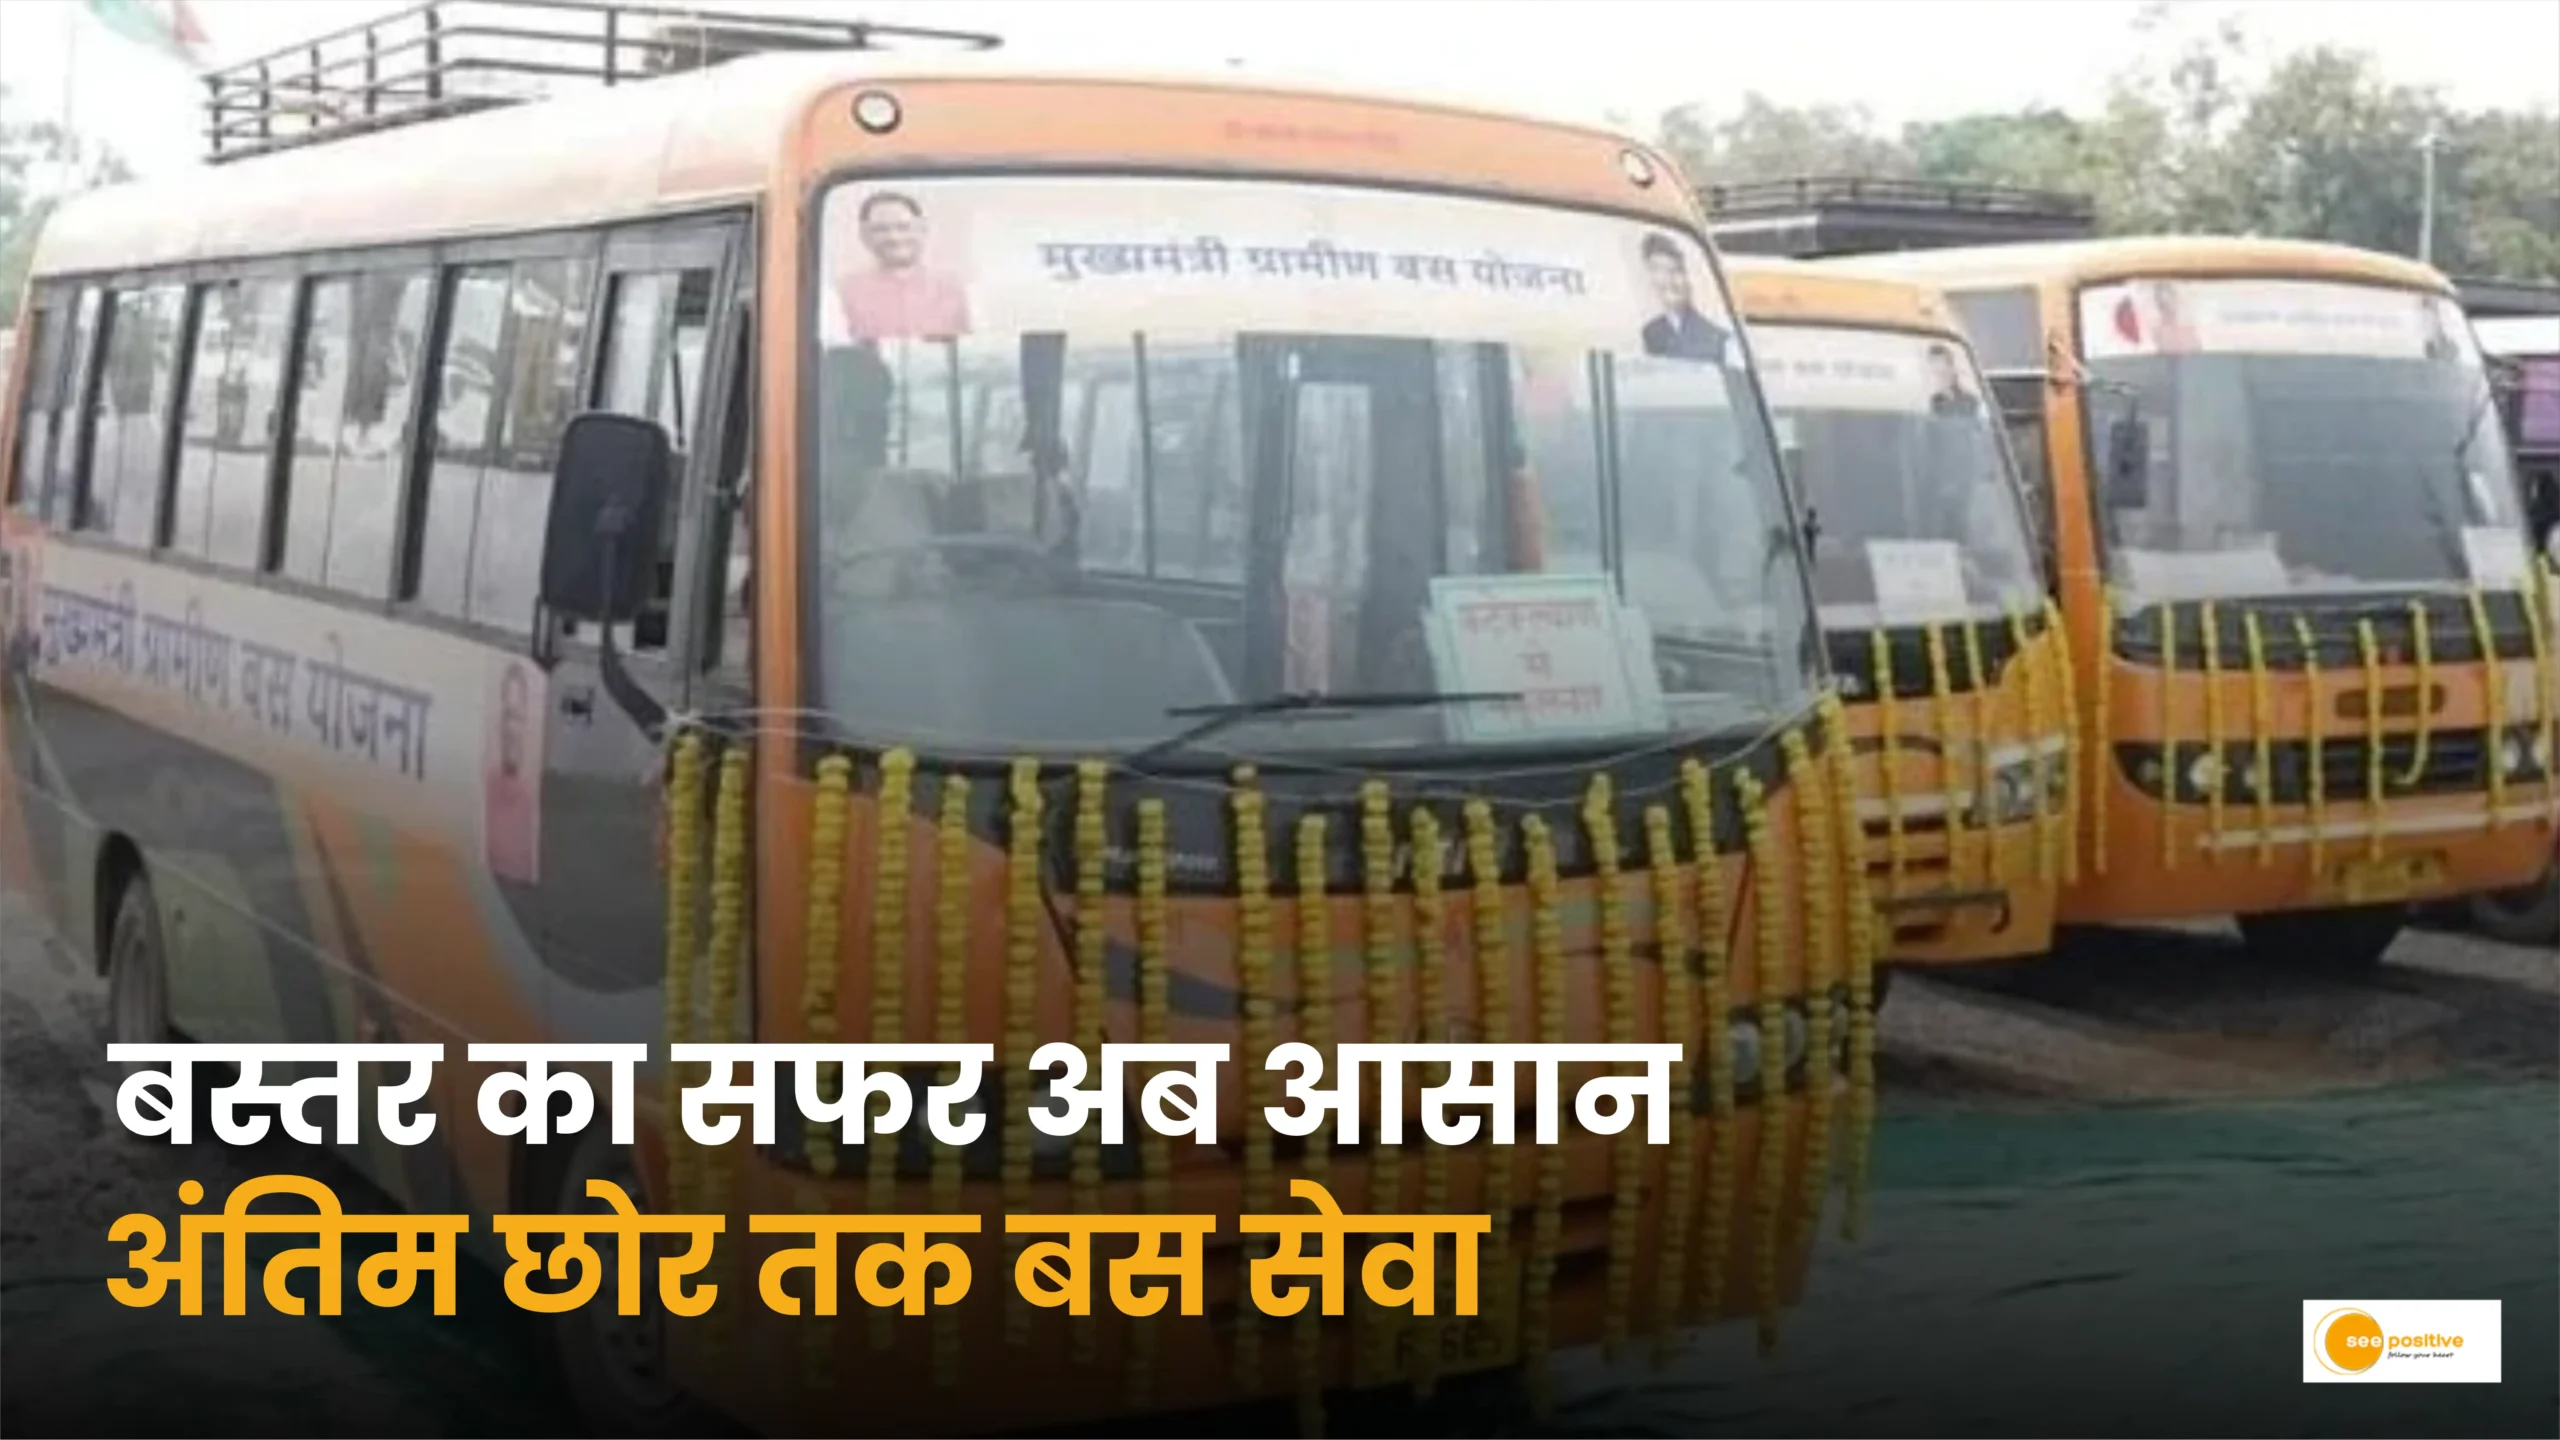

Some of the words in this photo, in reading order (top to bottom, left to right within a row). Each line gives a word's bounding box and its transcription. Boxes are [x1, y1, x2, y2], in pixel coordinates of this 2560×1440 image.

[1036, 234, 1229, 281] मुख्यमंत्री
[1242, 239, 1379, 280] ग्रामीण
[1391, 252, 1457, 286] बस
[1467, 248, 1587, 296] योजना
[240, 639, 297, 735] बस
[306, 630, 433, 780] योजना
